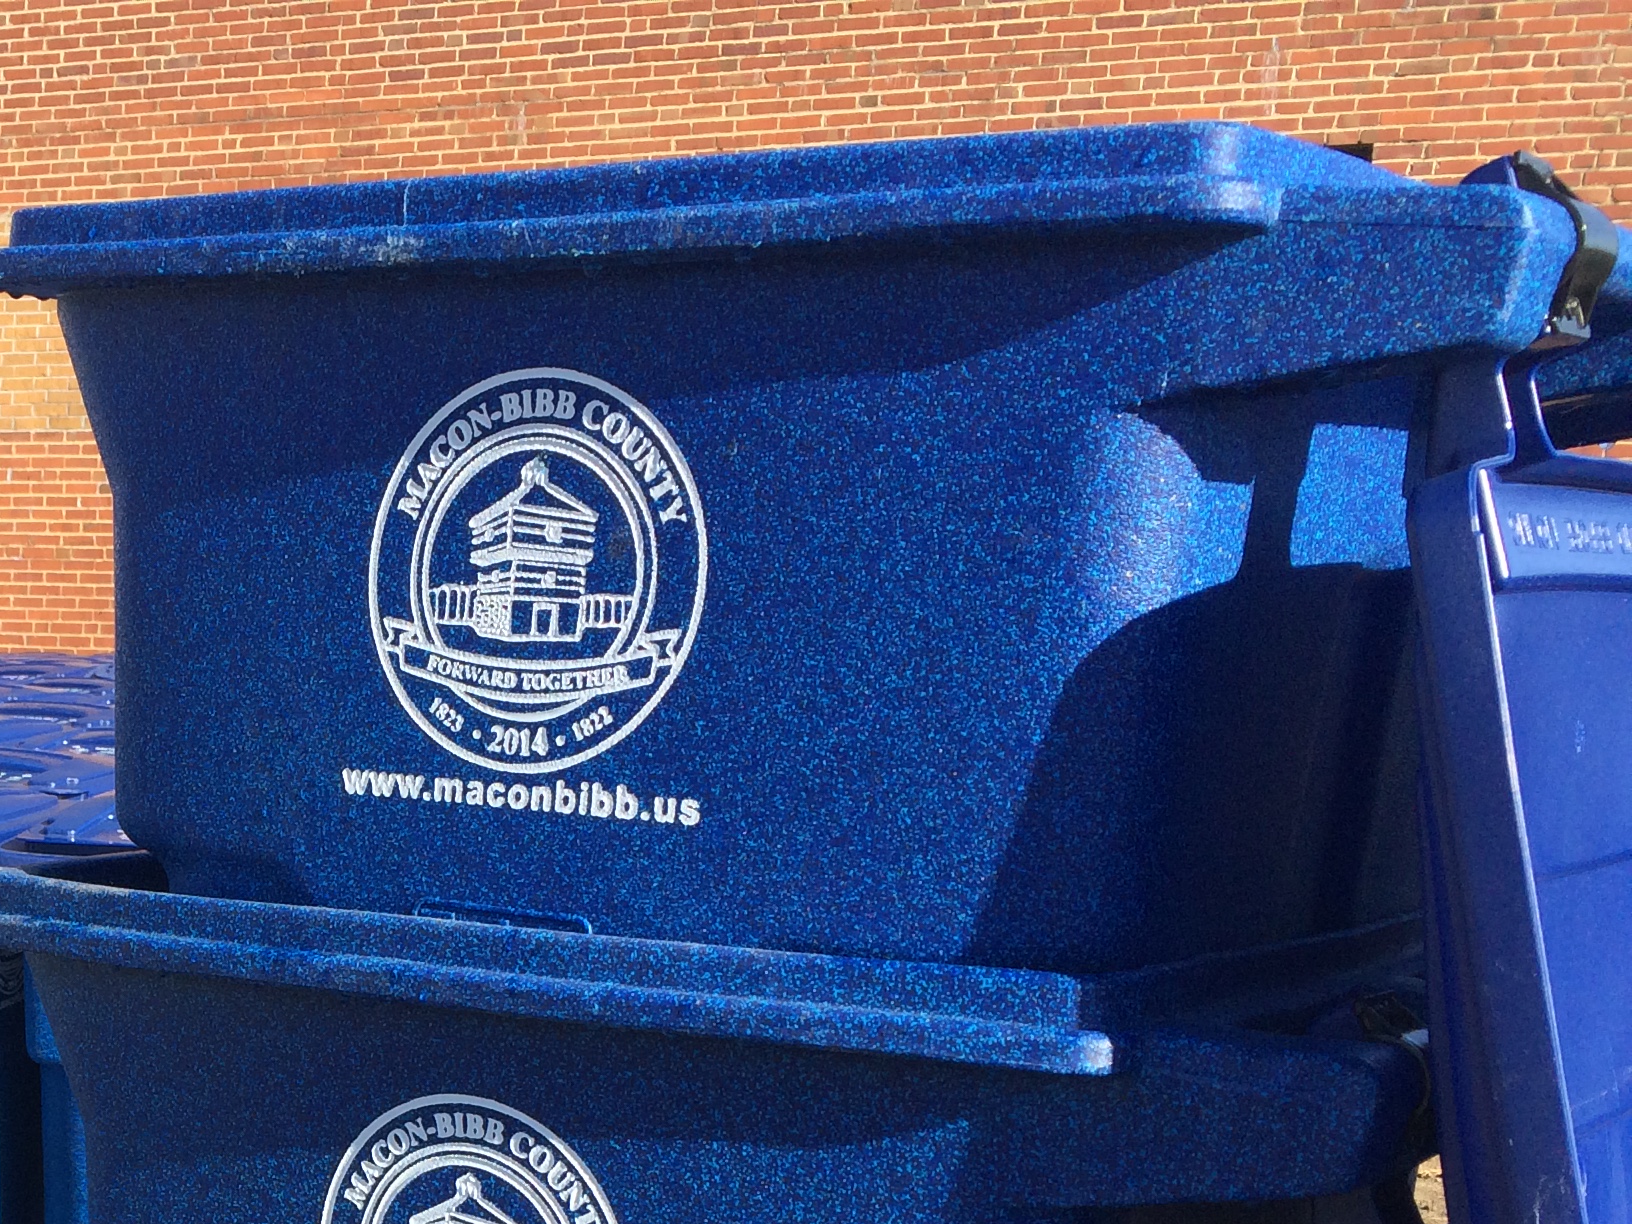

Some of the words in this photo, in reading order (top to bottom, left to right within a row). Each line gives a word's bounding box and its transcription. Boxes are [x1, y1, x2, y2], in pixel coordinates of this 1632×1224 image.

[397, 388, 576, 520] MACON-BIBB
[582, 400, 687, 525] COUNTY
[426, 654, 518, 690] FORWARD
[521, 662, 630, 690] TOGETHER
[428, 697, 464, 731] 1823
[488, 726, 549, 756] 2014
[342, 766, 701, 826] www.maconbibb.us
[343, 1112, 505, 1210] MACON-BIBB
